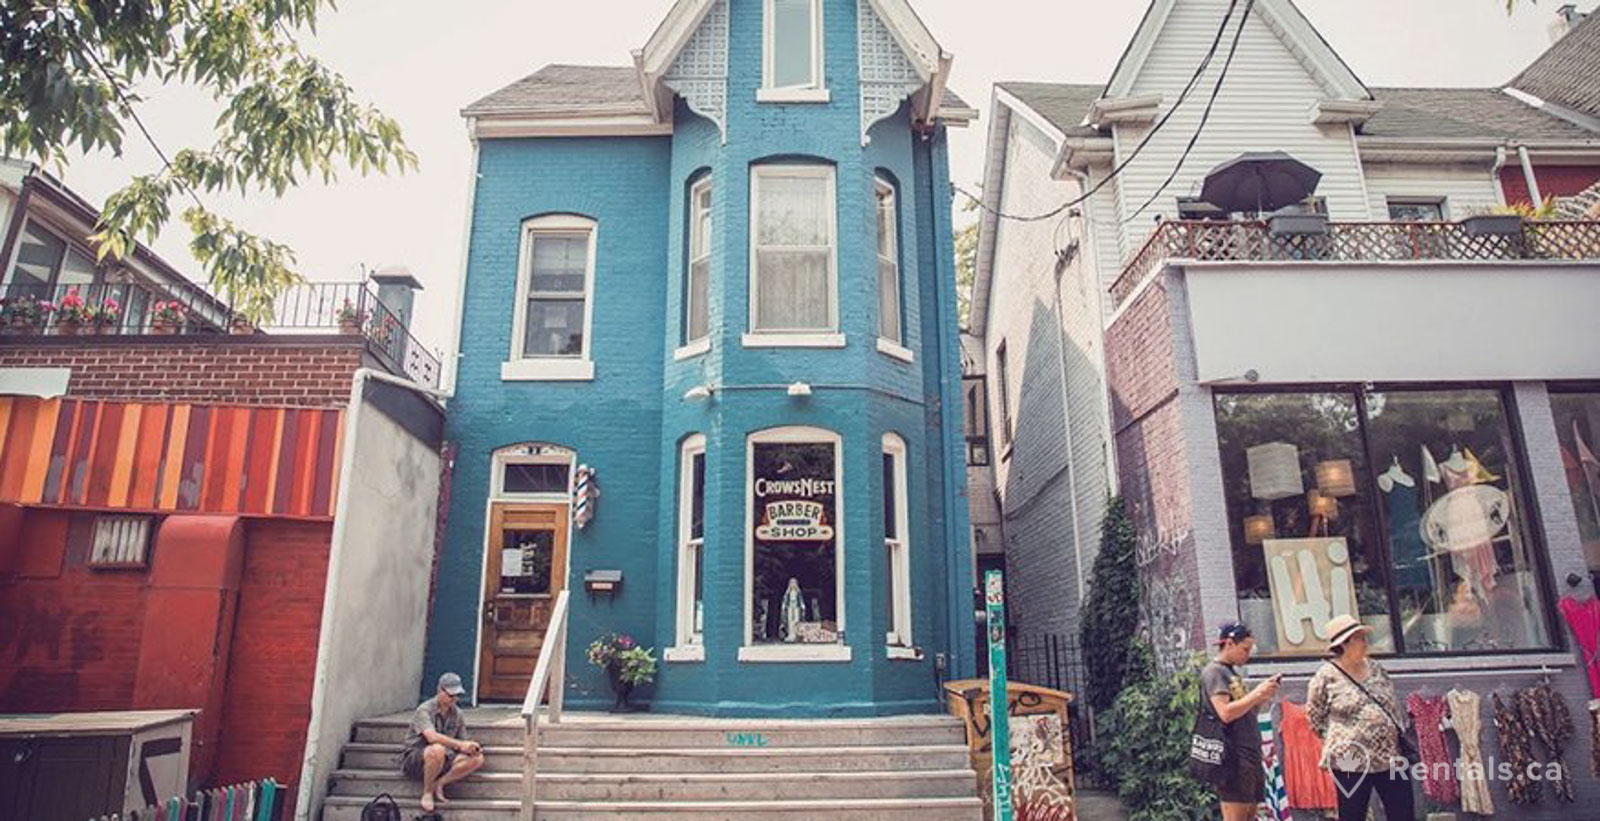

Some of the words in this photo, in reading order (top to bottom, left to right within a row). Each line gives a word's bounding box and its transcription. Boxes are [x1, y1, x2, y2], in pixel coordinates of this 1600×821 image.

[768, 503, 820, 520] BARBER
[771, 526, 817, 537] SHOP
[1271, 542, 1348, 644] Hi
